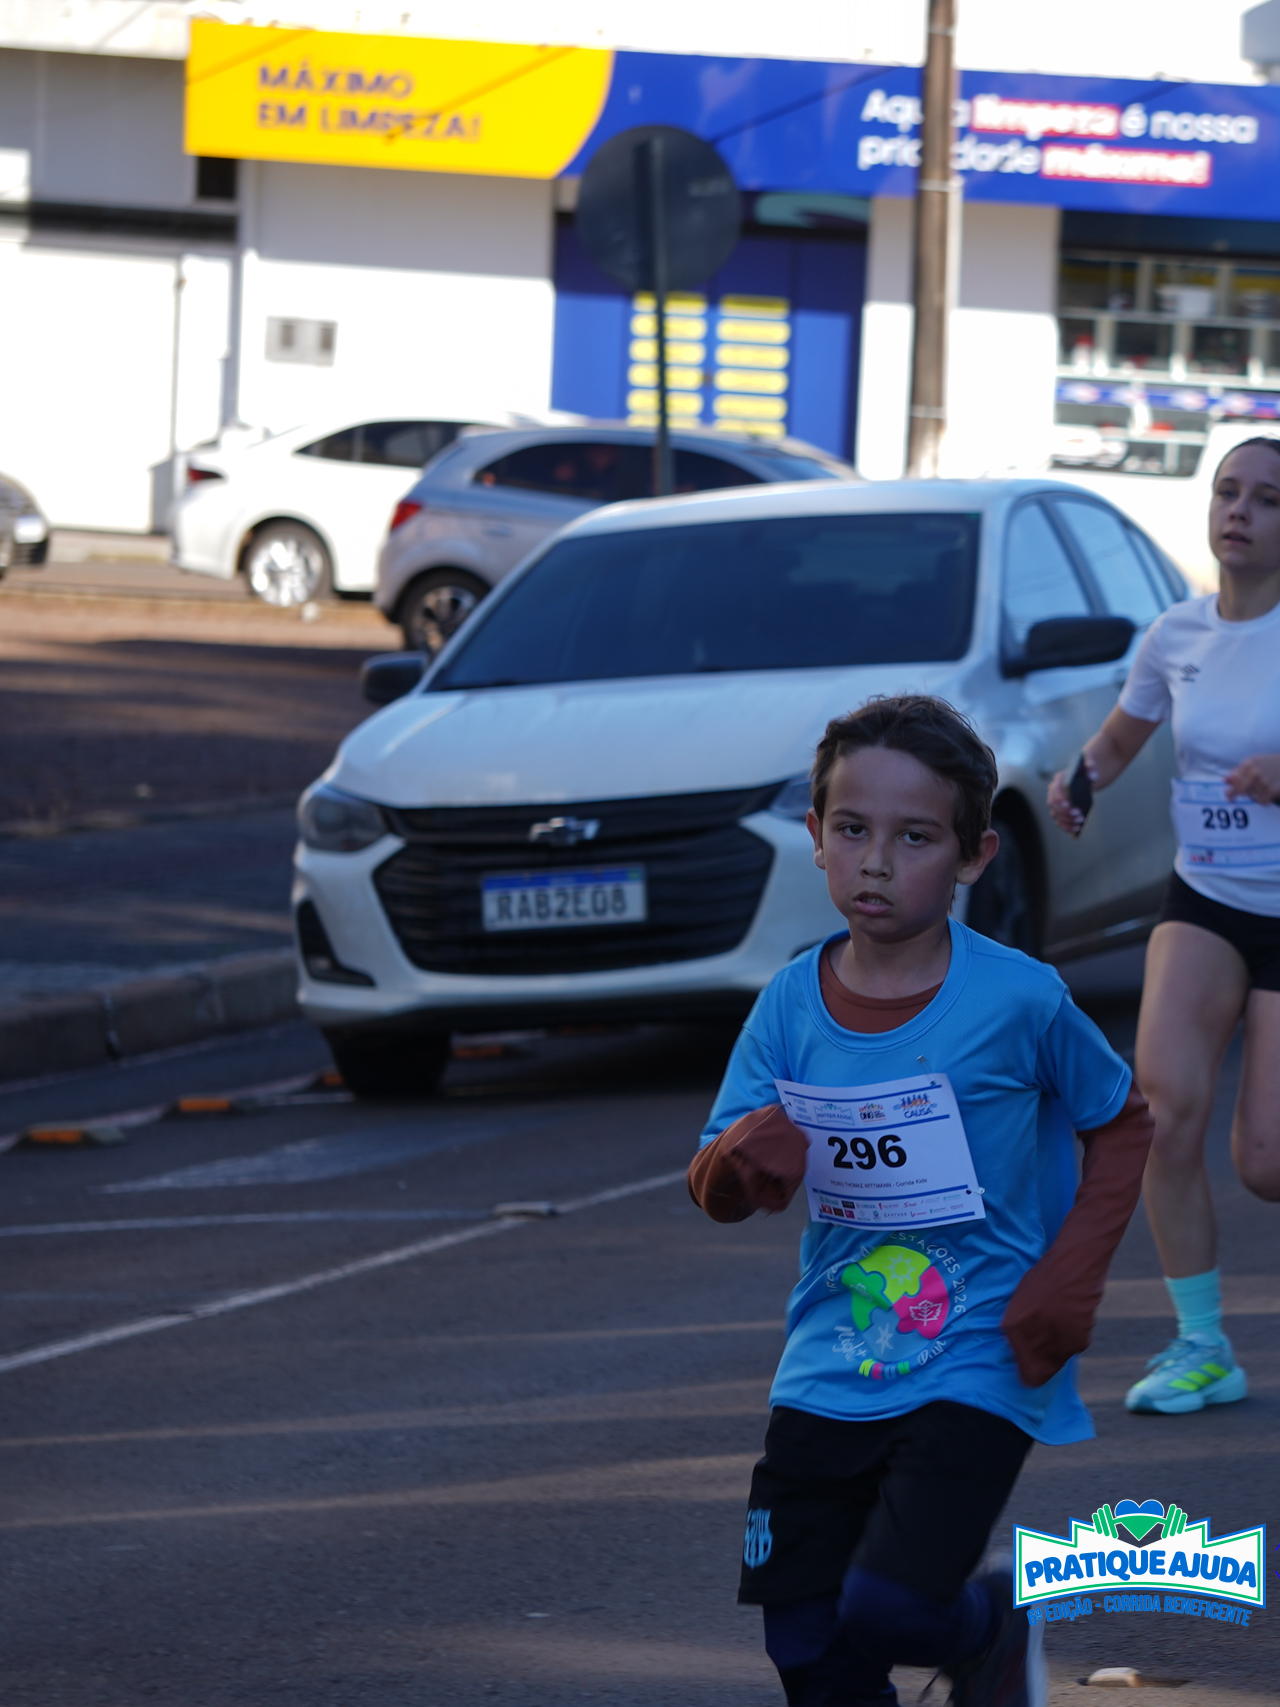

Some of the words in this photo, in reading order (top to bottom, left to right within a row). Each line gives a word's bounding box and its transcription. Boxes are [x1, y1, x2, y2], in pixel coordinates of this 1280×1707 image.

[258, 57, 415, 99] MÁXIMO
[258, 102, 306, 129] EM
[320, 107, 481, 143] LIMPEZA!
[1120, 102, 1149, 138] é
[1150, 110, 1258, 144] nossa
[1201, 807, 1249, 830] 299
[497, 885, 627, 921] RAB2E08
[828, 1134, 907, 1170] 296
[895, 1179, 915, 1188] Corrida
[952, 1277, 968, 1314] 2026
